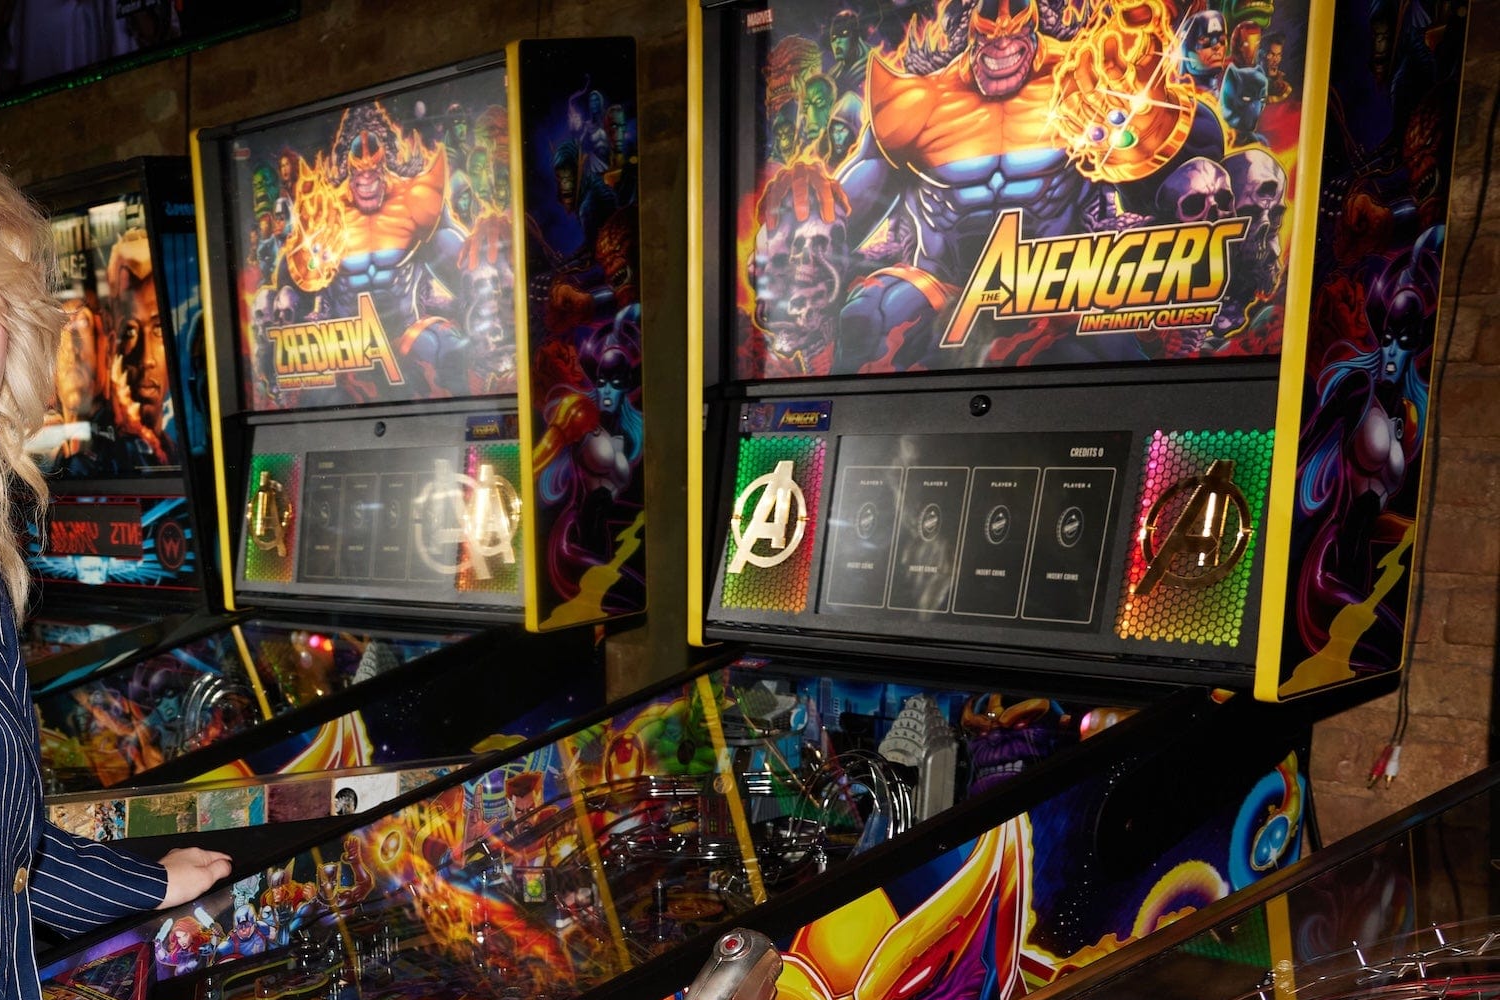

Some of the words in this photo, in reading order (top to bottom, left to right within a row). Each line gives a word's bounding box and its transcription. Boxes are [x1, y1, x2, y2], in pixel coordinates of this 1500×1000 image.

[941, 208, 1252, 347] AVENGERS
[981, 292, 1002, 303] THE
[1081, 310, 1154, 333] INFINITY
[1153, 306, 1218, 329] QUEST
[1070, 447, 1098, 458] CREDITS
